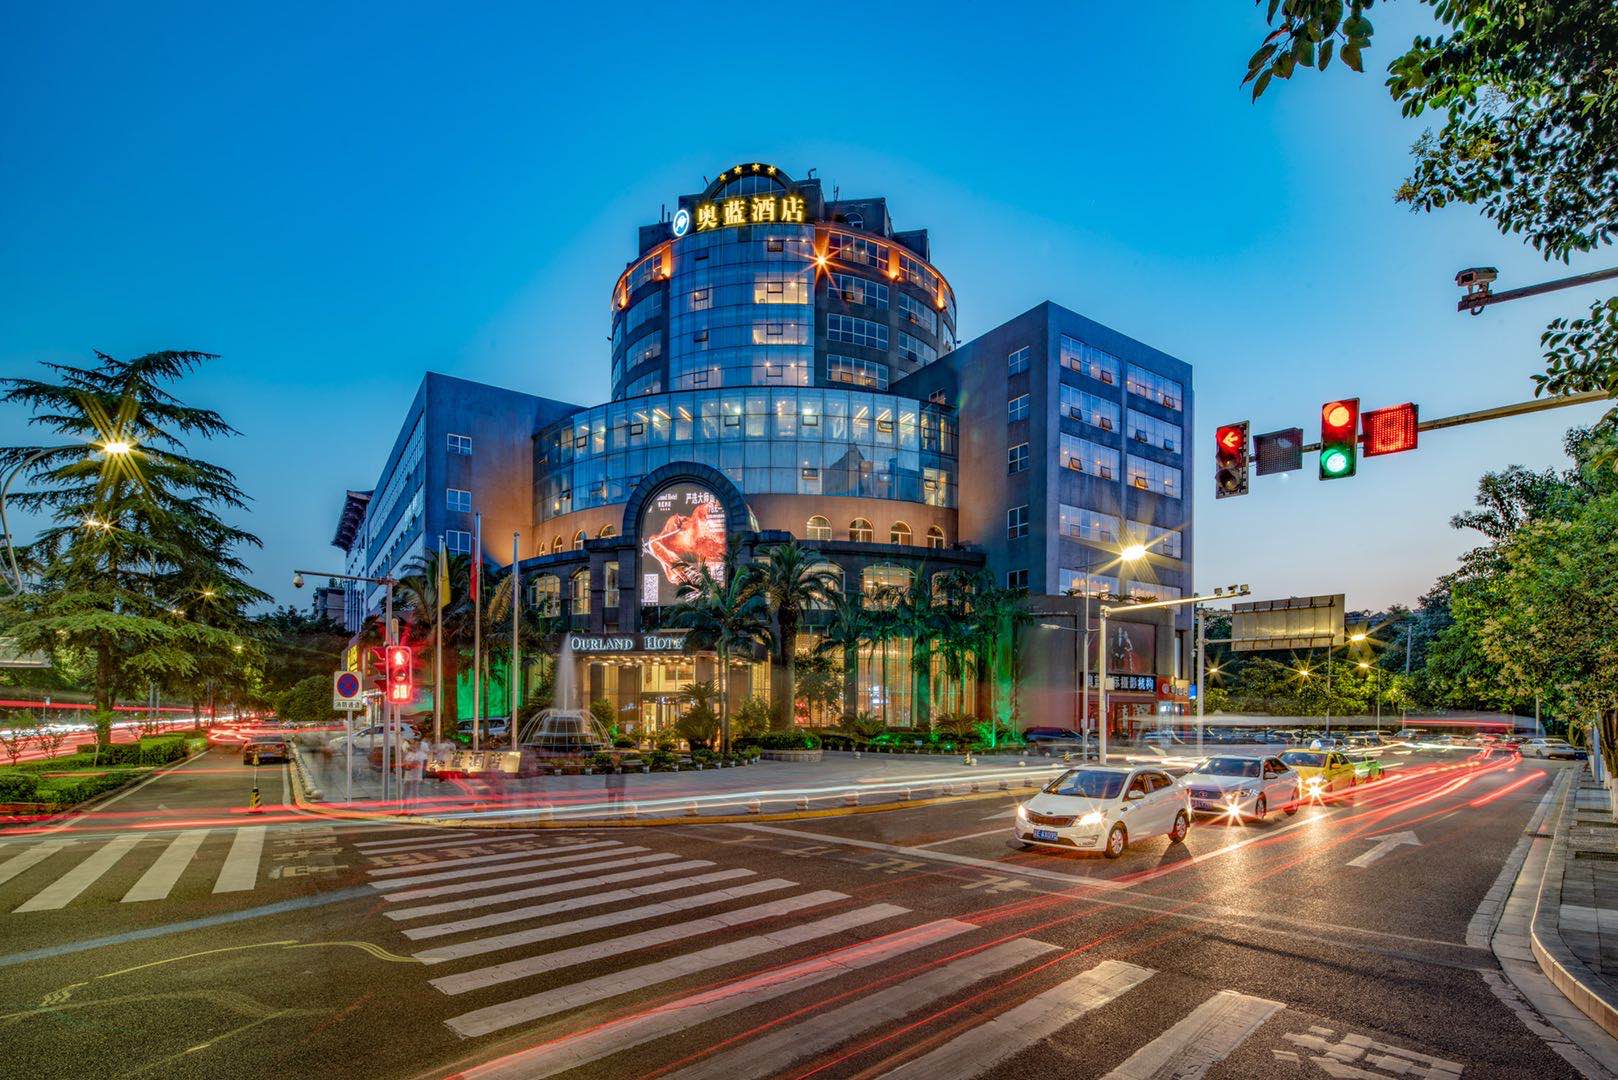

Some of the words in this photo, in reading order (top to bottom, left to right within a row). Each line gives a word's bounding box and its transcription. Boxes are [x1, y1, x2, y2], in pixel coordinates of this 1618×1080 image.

[697, 197, 804, 231] 奥蓝酒店
[571, 636, 633, 650] OURLAND
[644, 635, 686, 650] HOTE
